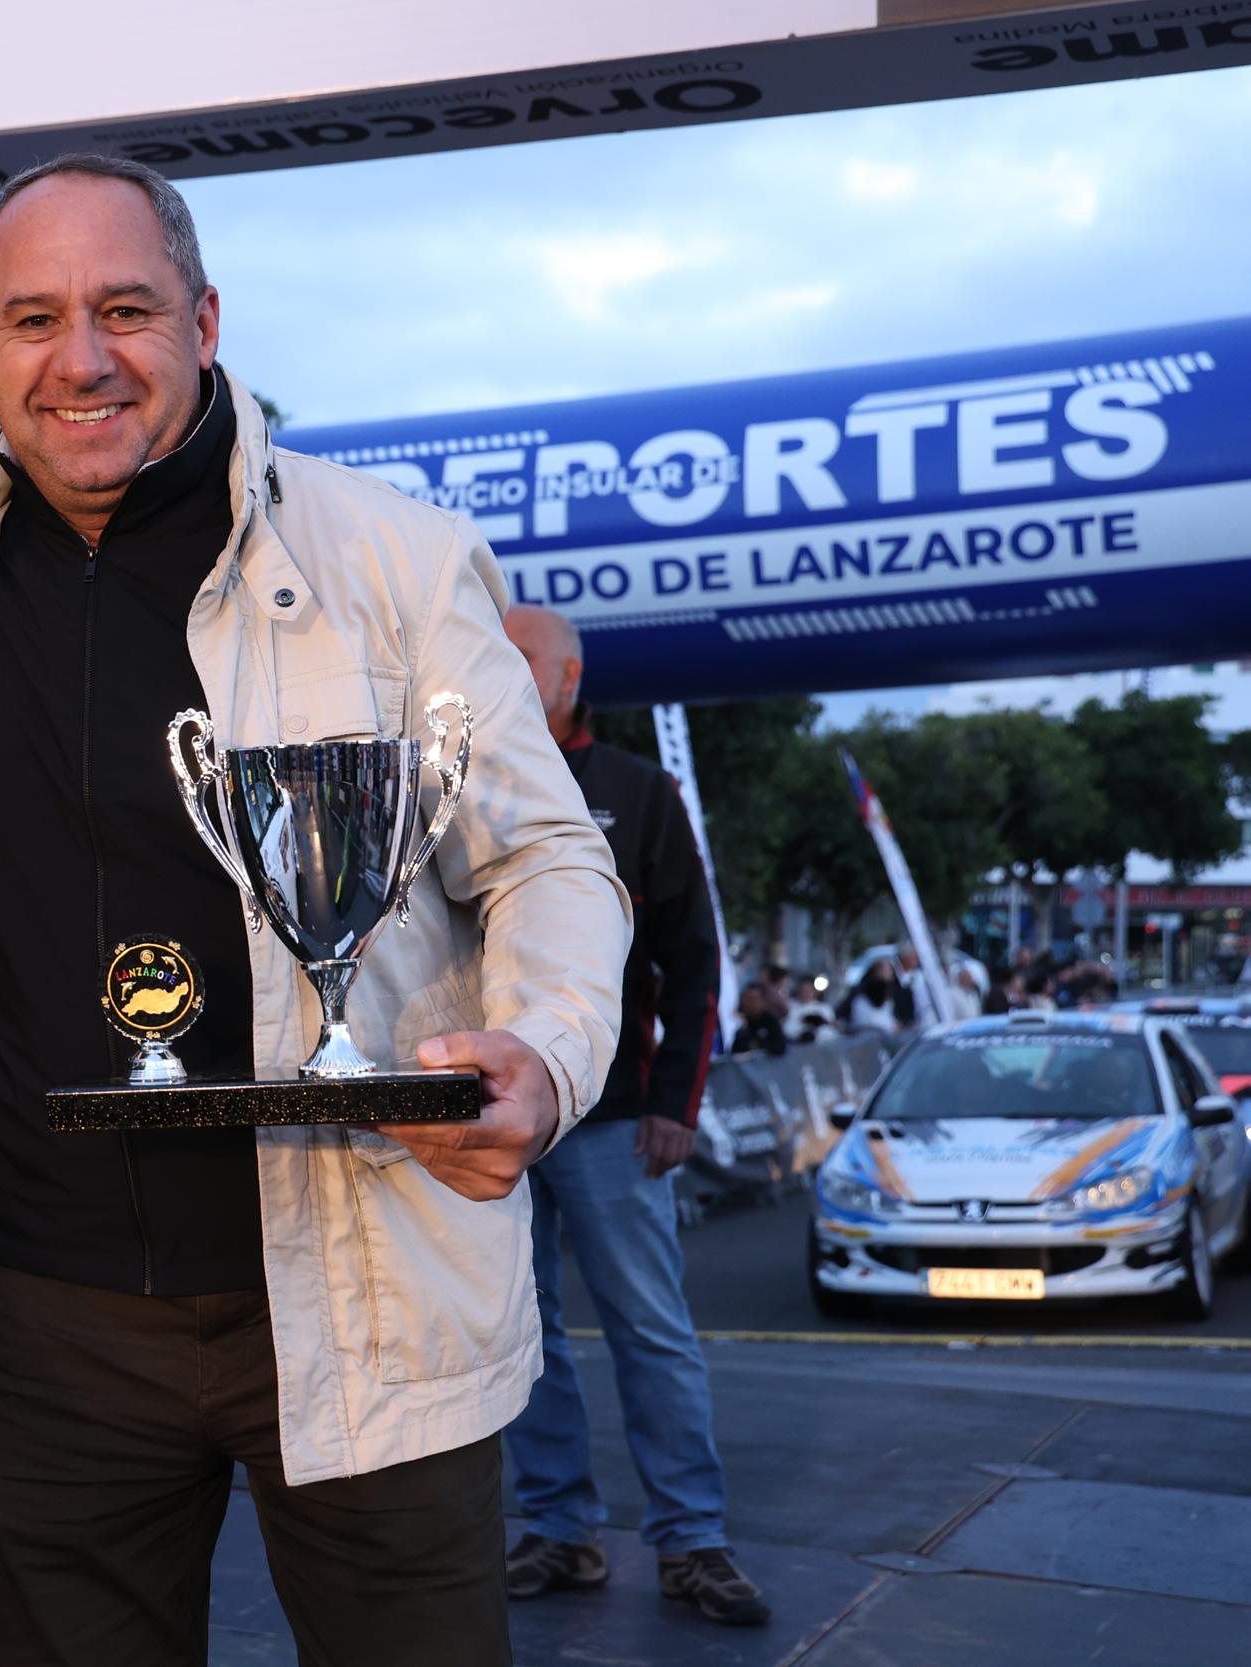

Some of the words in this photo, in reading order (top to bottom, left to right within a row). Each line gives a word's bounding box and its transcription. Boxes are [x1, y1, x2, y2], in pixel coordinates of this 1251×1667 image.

[121, 79, 762, 164] Orvecame
[535, 463, 684, 501] INSULAR
[690, 455, 740, 487] DE
[653, 553, 731, 596] DE
[750, 510, 1139, 588] LANZAROTE
[114, 967, 177, 985] LANZAROTE
